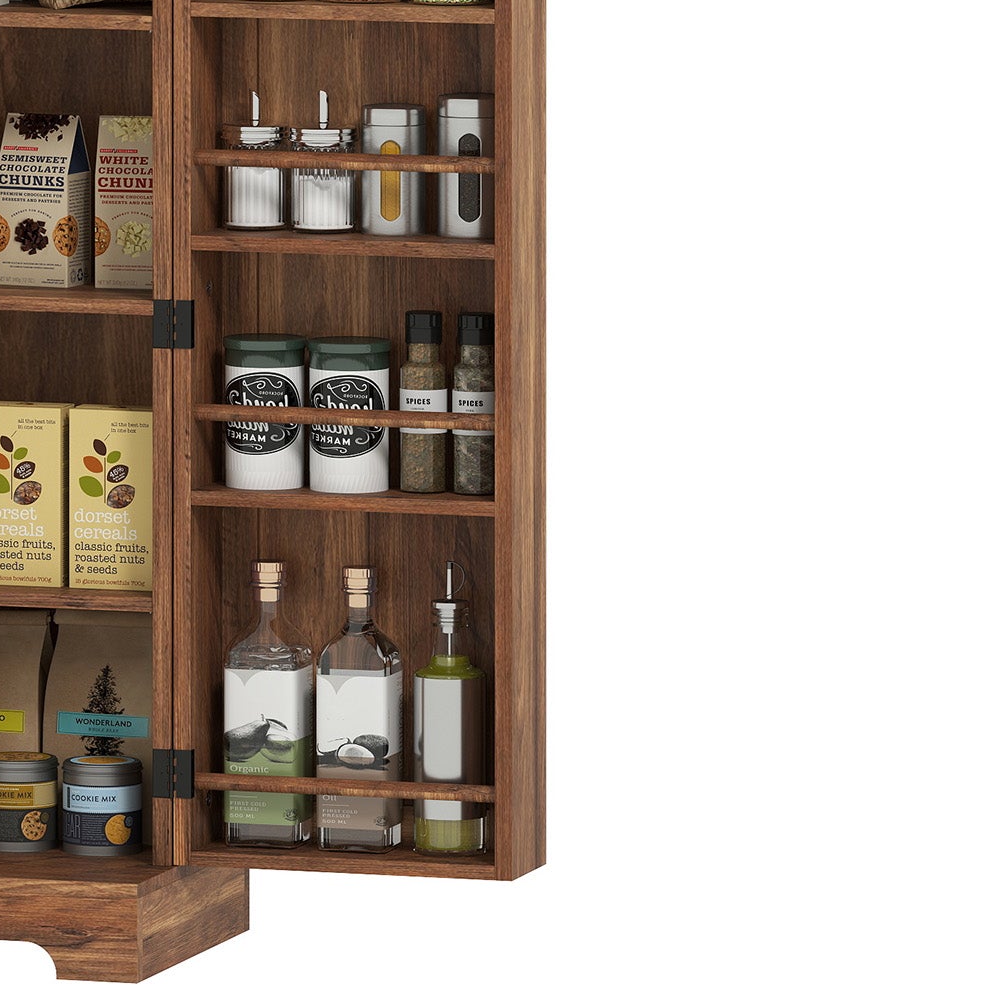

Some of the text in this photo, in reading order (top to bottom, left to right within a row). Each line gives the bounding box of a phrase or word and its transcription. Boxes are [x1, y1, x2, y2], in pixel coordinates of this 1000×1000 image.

[1, 154, 68, 164] SEMISWEET
[99, 155, 149, 165] WHITE
[0, 164, 66, 174] CHOCOLATE
[458, 399, 484, 407] SPICES
[74, 508, 131, 524] dorset
[74, 526, 137, 540] cereals
[22, 539, 56, 550] fruits,
[74, 541, 149, 554] classic fruits,
[26, 551, 52, 561] nuts
[74, 554, 145, 564] roasted nuts
[74, 564, 118, 574] & seeds
[75, 718, 132, 728] WONDERLAND
[229, 764, 269, 773] Organic
[71, 794, 99, 802] COOKIE
